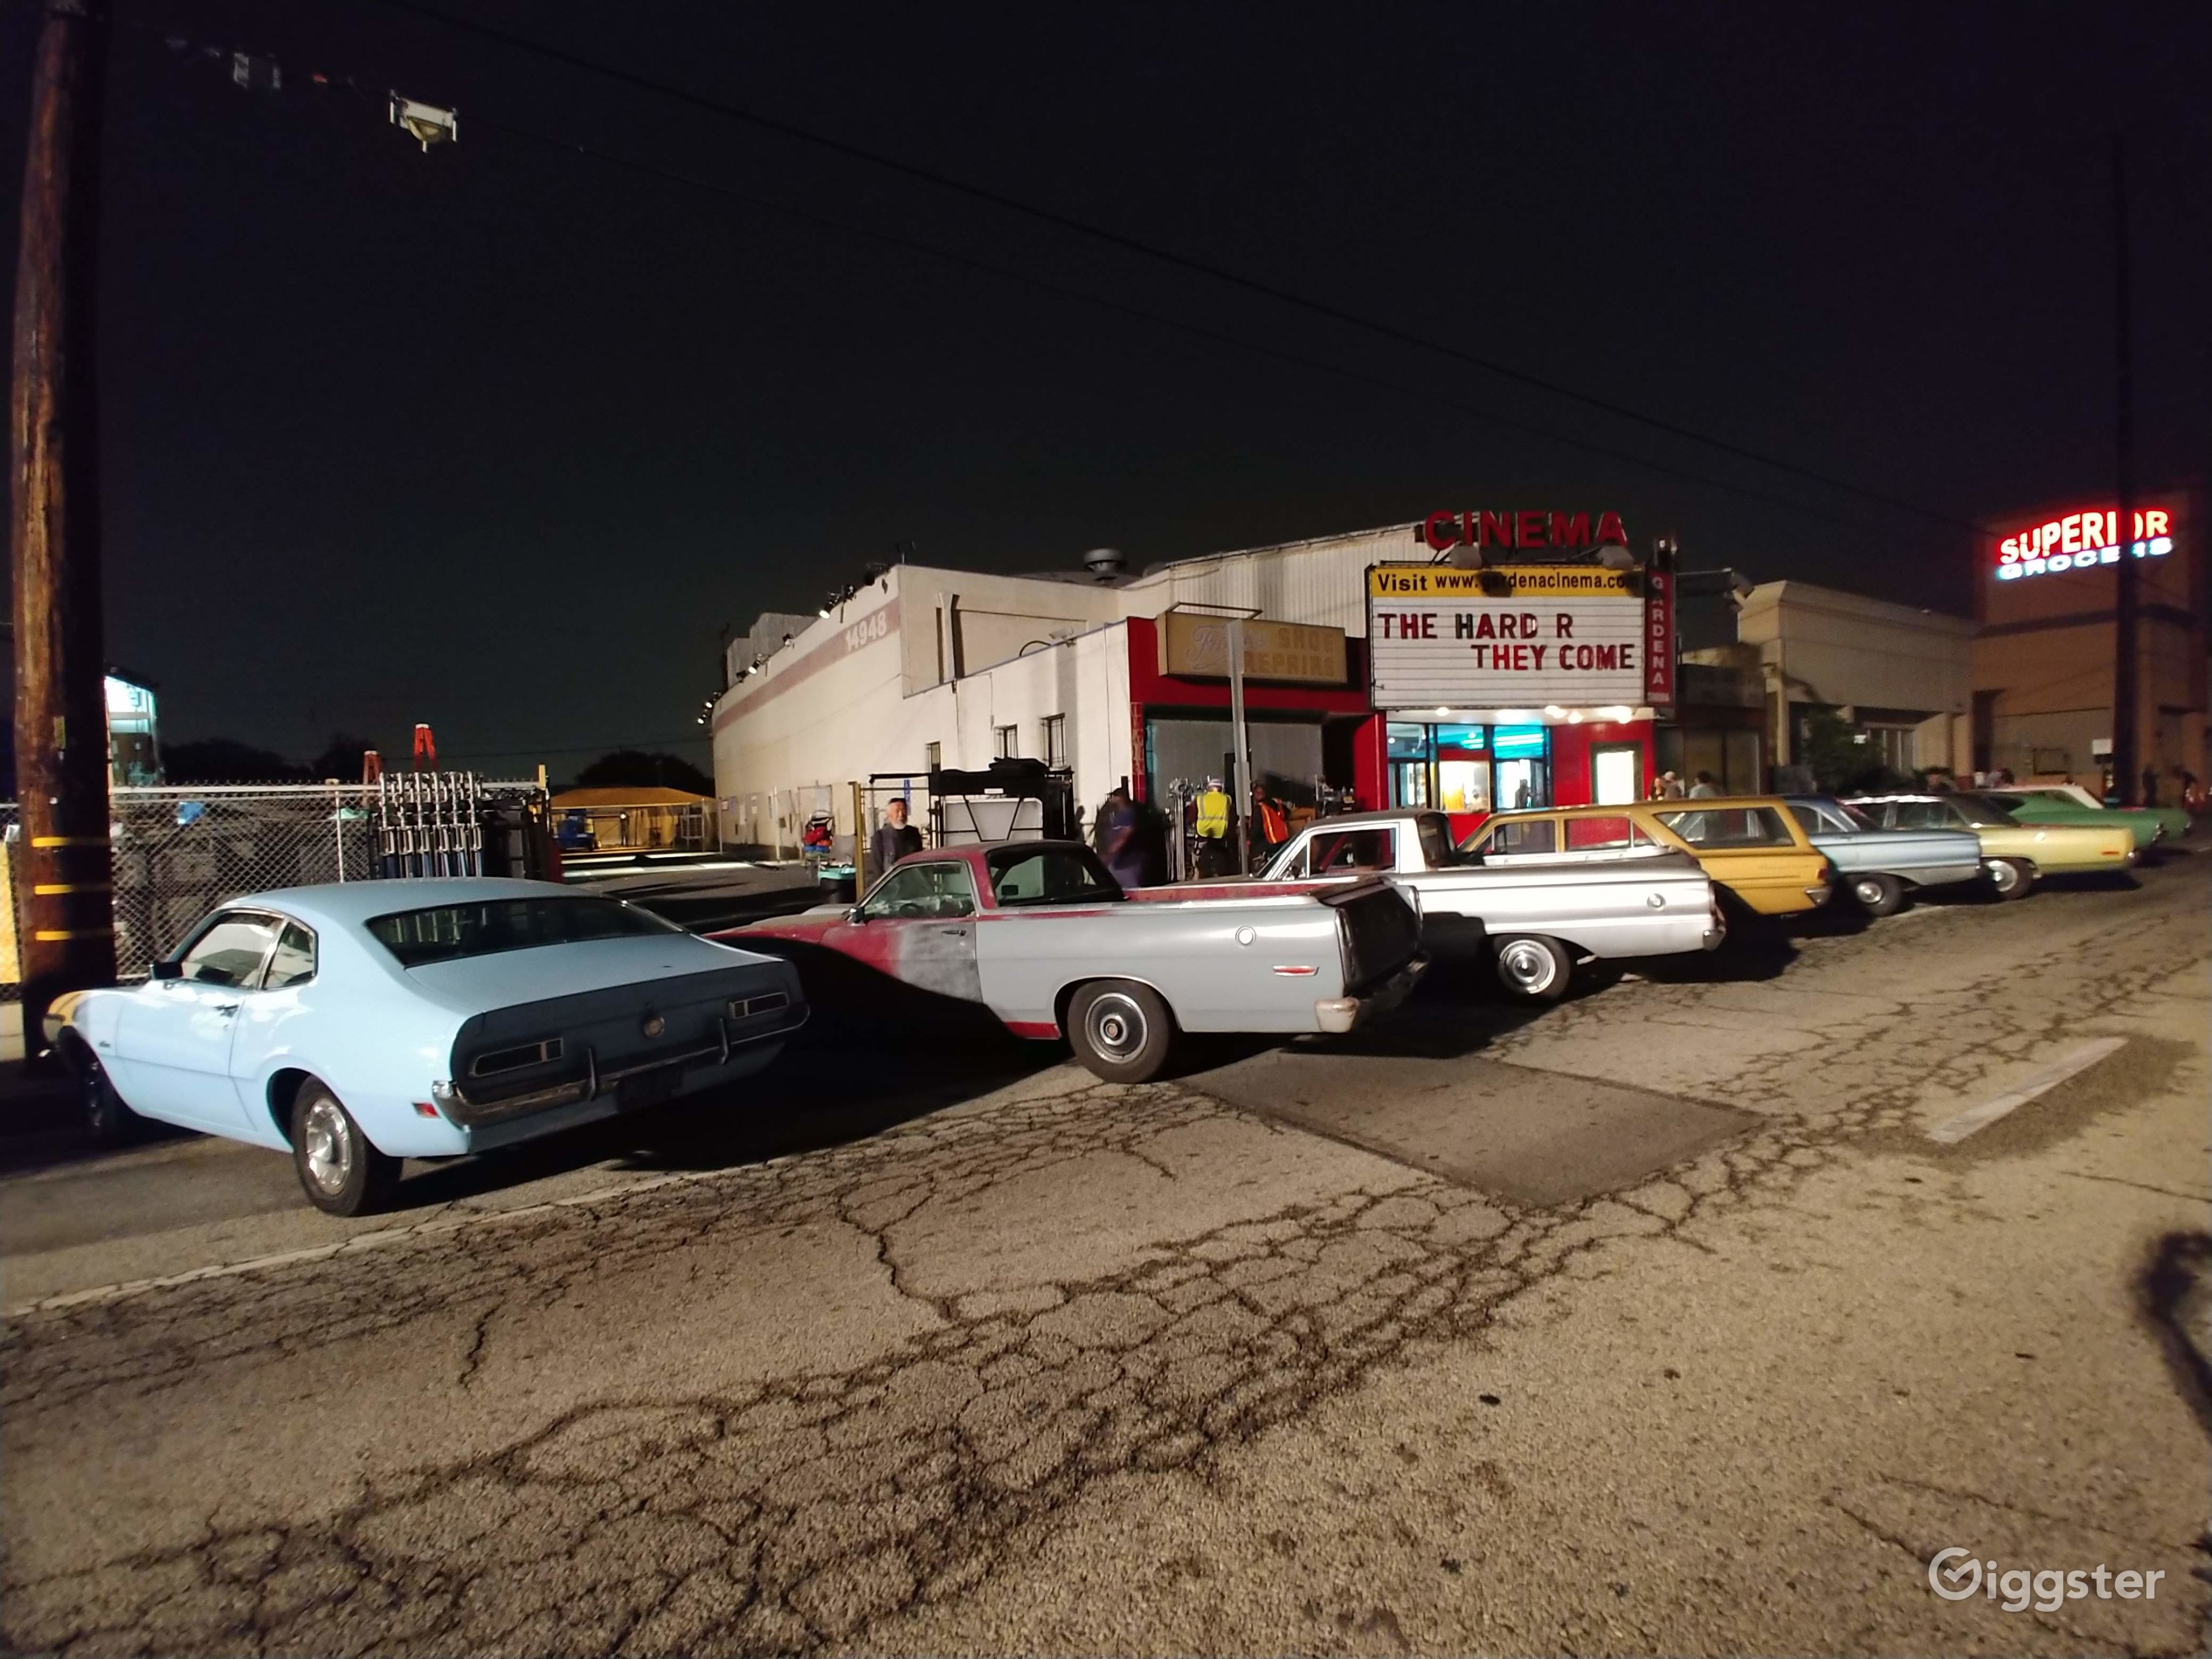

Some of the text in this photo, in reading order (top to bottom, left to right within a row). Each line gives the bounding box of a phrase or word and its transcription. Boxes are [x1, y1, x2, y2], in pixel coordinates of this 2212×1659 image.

[1425, 509, 1629, 550] CINEMA
[1377, 574, 1427, 592] Visit
[846, 611, 887, 652] 14948
[1377, 613, 1573, 639] THE HARD R
[1651, 576, 1665, 685] GARDENA
[1277, 627, 1334, 653] SHOE
[1244, 650, 1334, 677] REPAIRS
[1471, 644, 1635, 671] THEY COME
